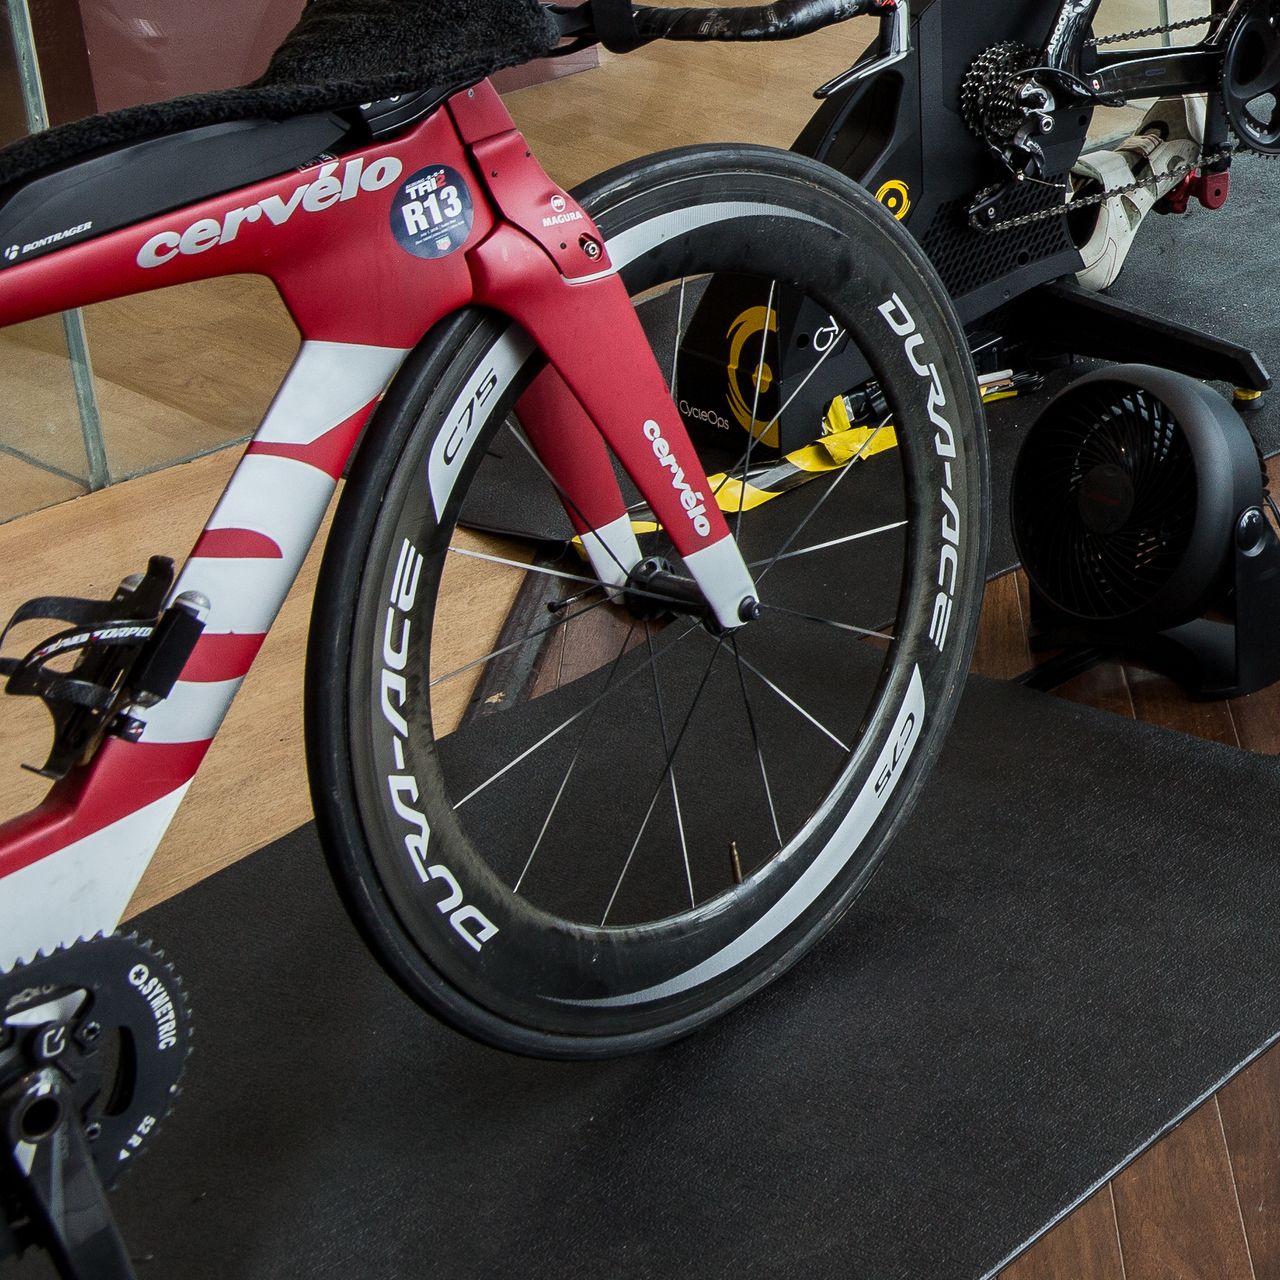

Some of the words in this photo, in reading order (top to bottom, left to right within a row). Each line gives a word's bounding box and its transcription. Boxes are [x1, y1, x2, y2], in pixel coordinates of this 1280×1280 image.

[21, 220, 93, 254] BONTRAGER
[136, 156, 404, 269] cervélo
[401, 185, 463, 236] R13
[542, 210, 584, 228] MAGURA
[441, 366, 499, 468] C75
[679, 399, 730, 432] CycleOps
[642, 418, 713, 538] cervélo
[877, 292, 961, 653] DURA-ACE
[380, 537, 500, 953] DURA-ACE
